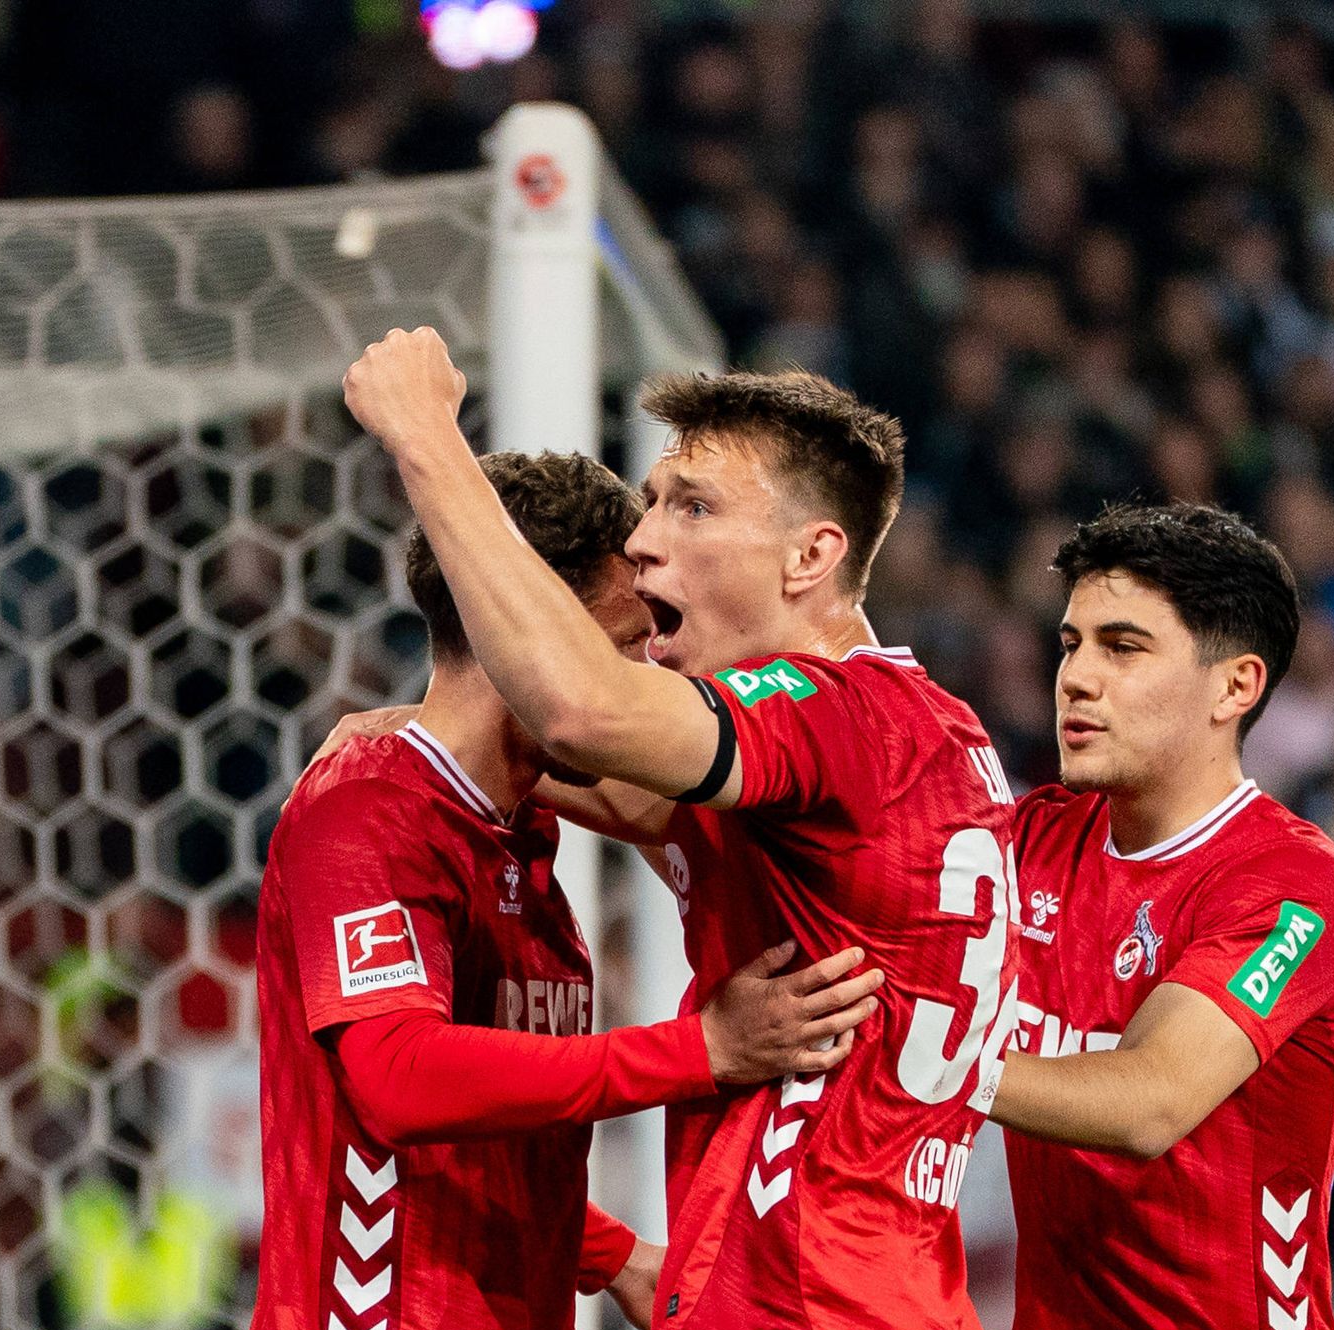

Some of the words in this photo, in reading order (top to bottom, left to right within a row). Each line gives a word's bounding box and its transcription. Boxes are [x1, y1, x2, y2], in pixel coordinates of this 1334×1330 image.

[726, 667, 804, 698] DVK
[1021, 924, 1057, 946] ummel
[1241, 913, 1316, 1005] DEVK
[348, 966, 421, 988] BUNDESLIGA
